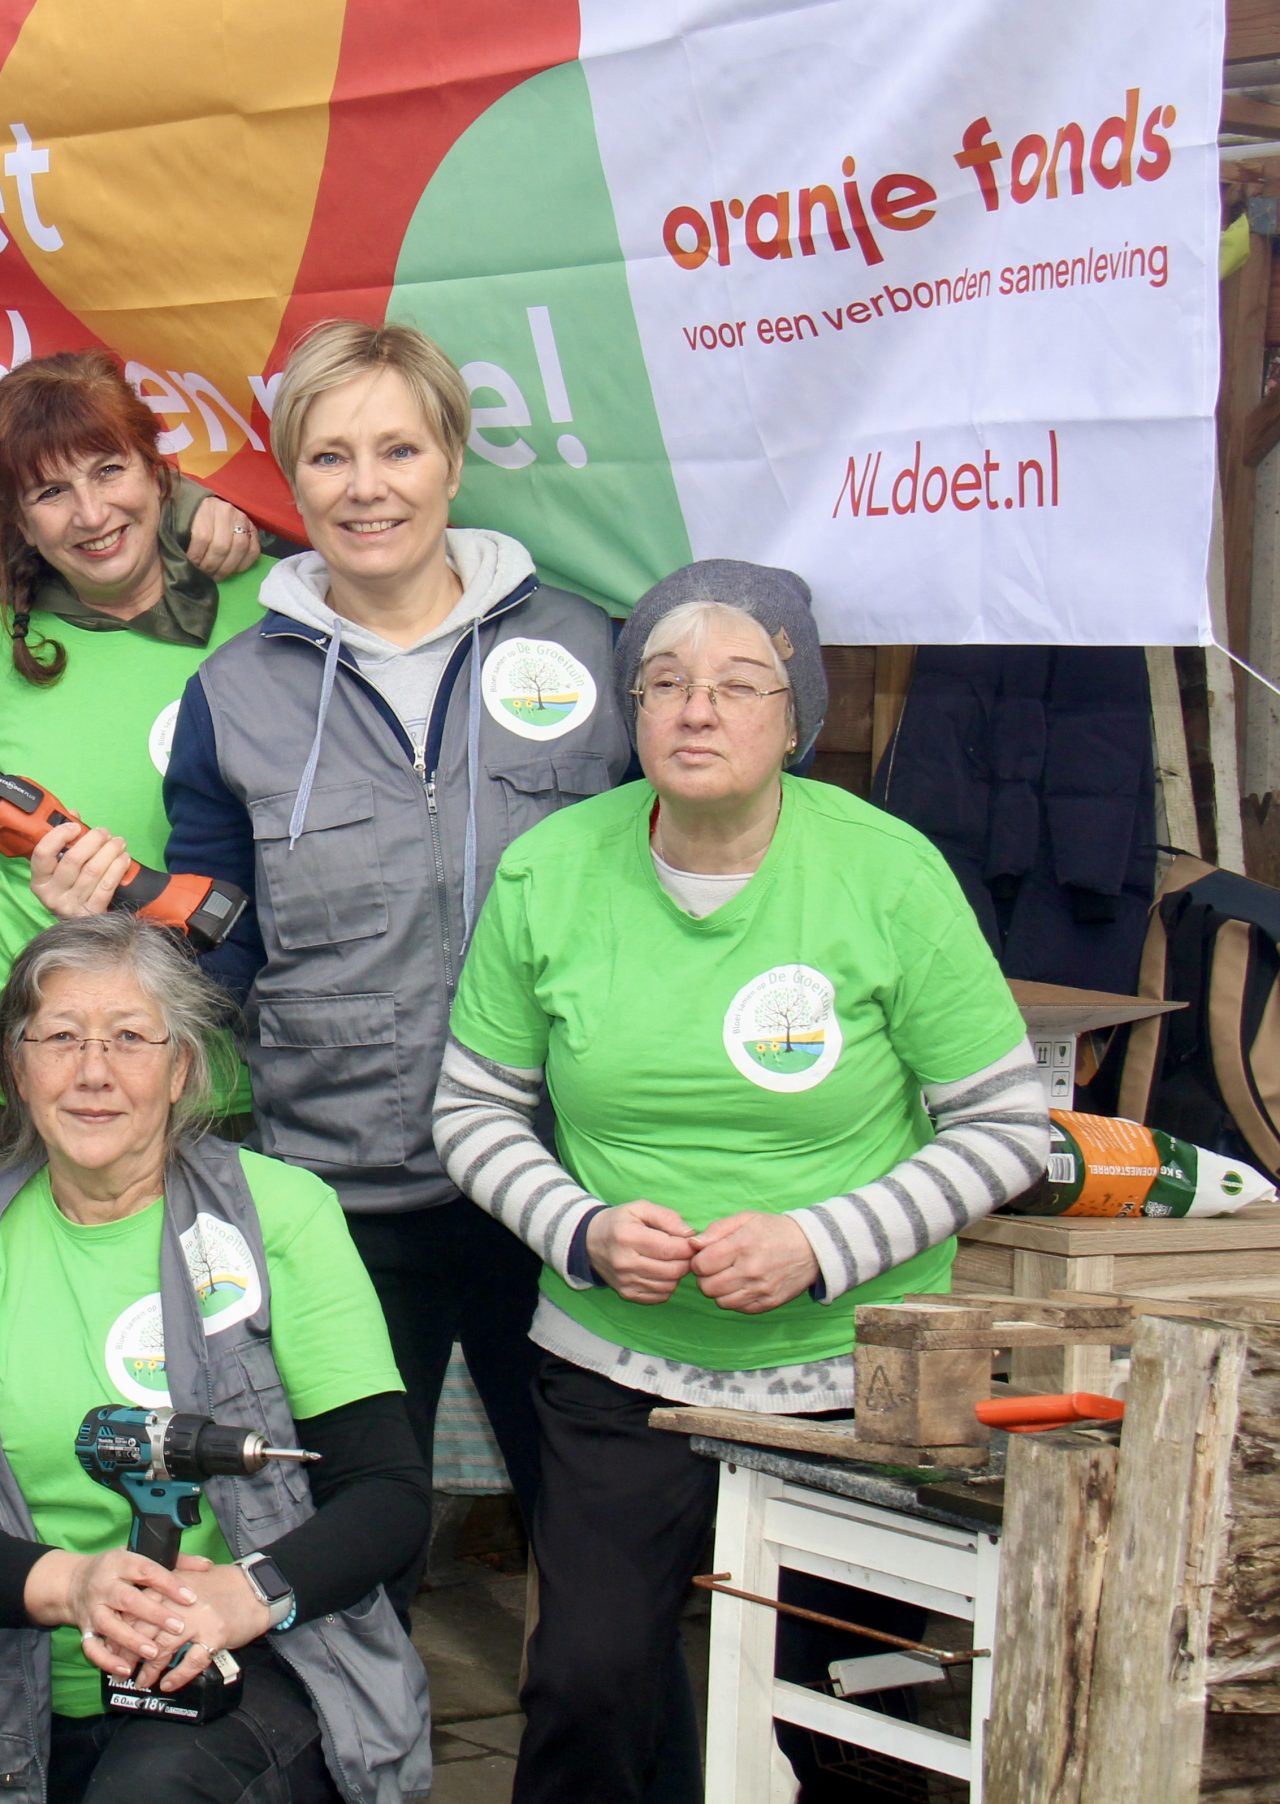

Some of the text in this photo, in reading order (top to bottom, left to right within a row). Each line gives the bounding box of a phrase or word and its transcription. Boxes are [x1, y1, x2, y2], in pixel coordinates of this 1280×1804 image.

[662, 87, 1177, 271] oranje fonds
[682, 241, 1168, 351] voor een verbonden samenleving
[832, 430, 1060, 519] NLdoet.nl
[536, 645, 585, 687] Groeituin
[767, 971, 787, 985] De
[1160, 1165, 1184, 1179] 5 KG
[205, 1218, 252, 1269] Groeituin
